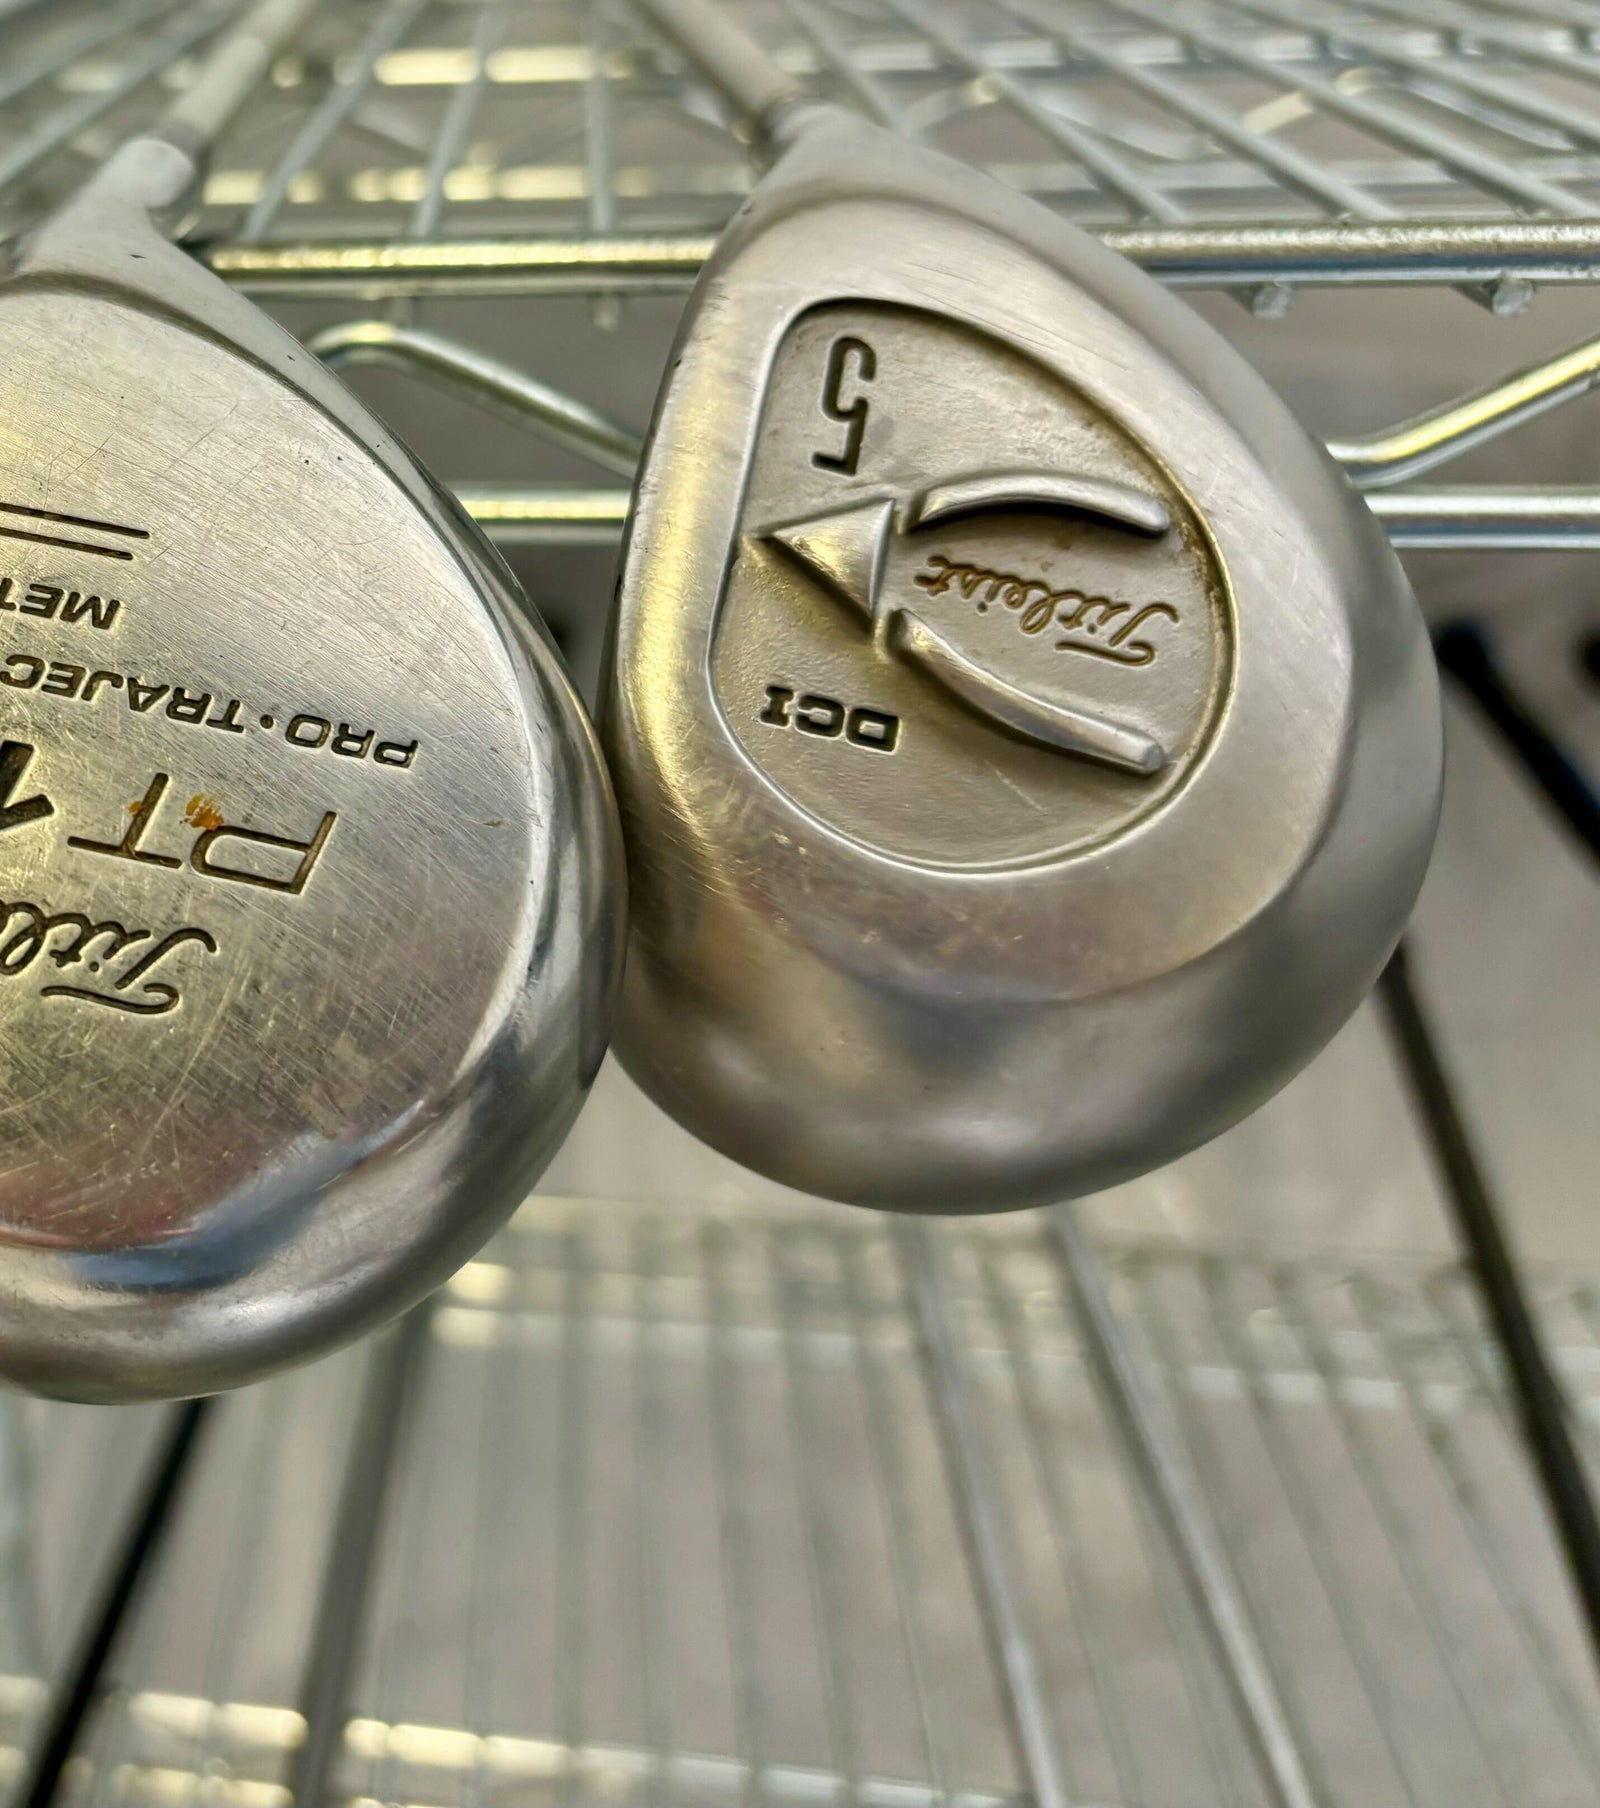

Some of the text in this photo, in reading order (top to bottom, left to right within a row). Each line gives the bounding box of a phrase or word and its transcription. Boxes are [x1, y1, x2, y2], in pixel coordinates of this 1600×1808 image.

[812, 335, 877, 476] 5
[912, 555, 1179, 666] Titleist
[759, 685, 900, 755] DCI
[67, 772, 338, 895] PT
